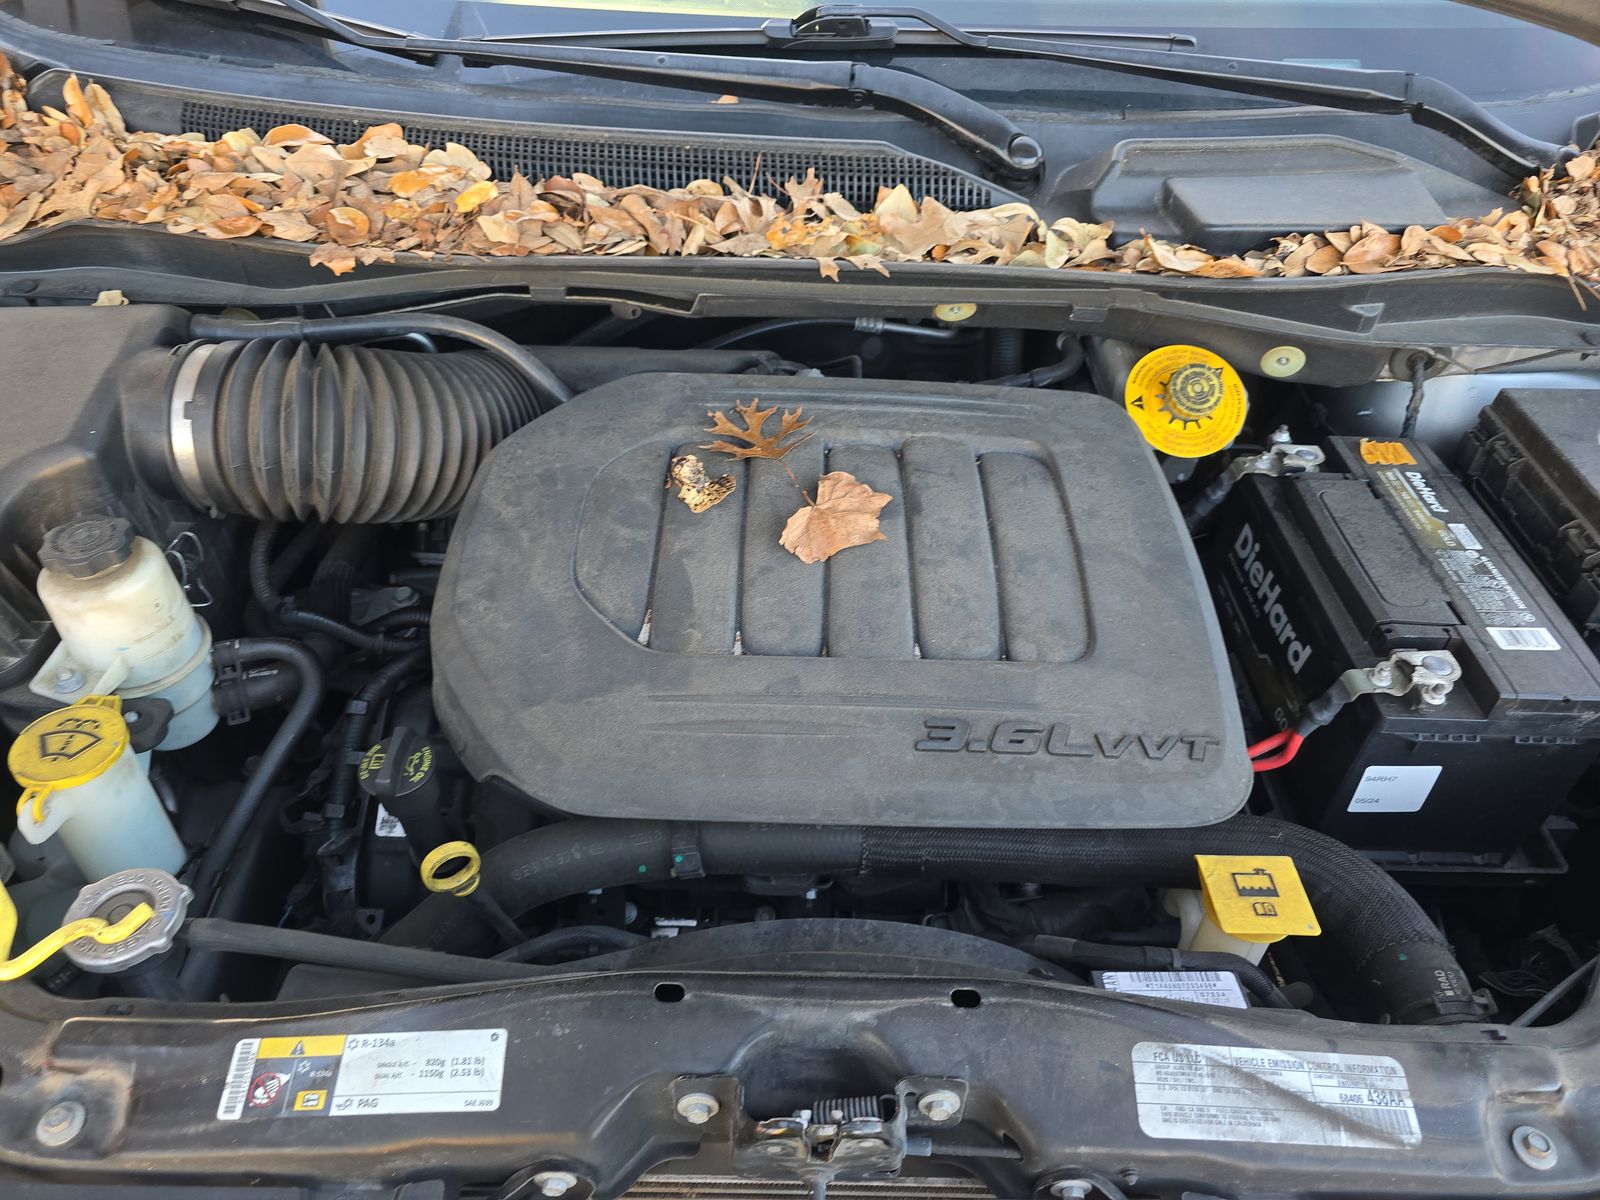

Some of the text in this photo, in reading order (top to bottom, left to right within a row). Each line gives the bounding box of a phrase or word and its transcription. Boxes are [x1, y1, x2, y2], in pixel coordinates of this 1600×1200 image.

[1405, 471, 1450, 513] DieHard
[1234, 522, 1313, 675] DieHard
[361, 1038, 397, 1049] R-134a
[424, 1057, 446, 1068] 820g
[1153, 1051, 1169, 1062] FCA
[1233, 1056, 1398, 1076] VEHICLE EMISSION CONTROL INFORMATION
[418, 1068, 445, 1079] 1150g
[357, 1097, 379, 1109] PAG
[1366, 1089, 1406, 1107] 438AA
